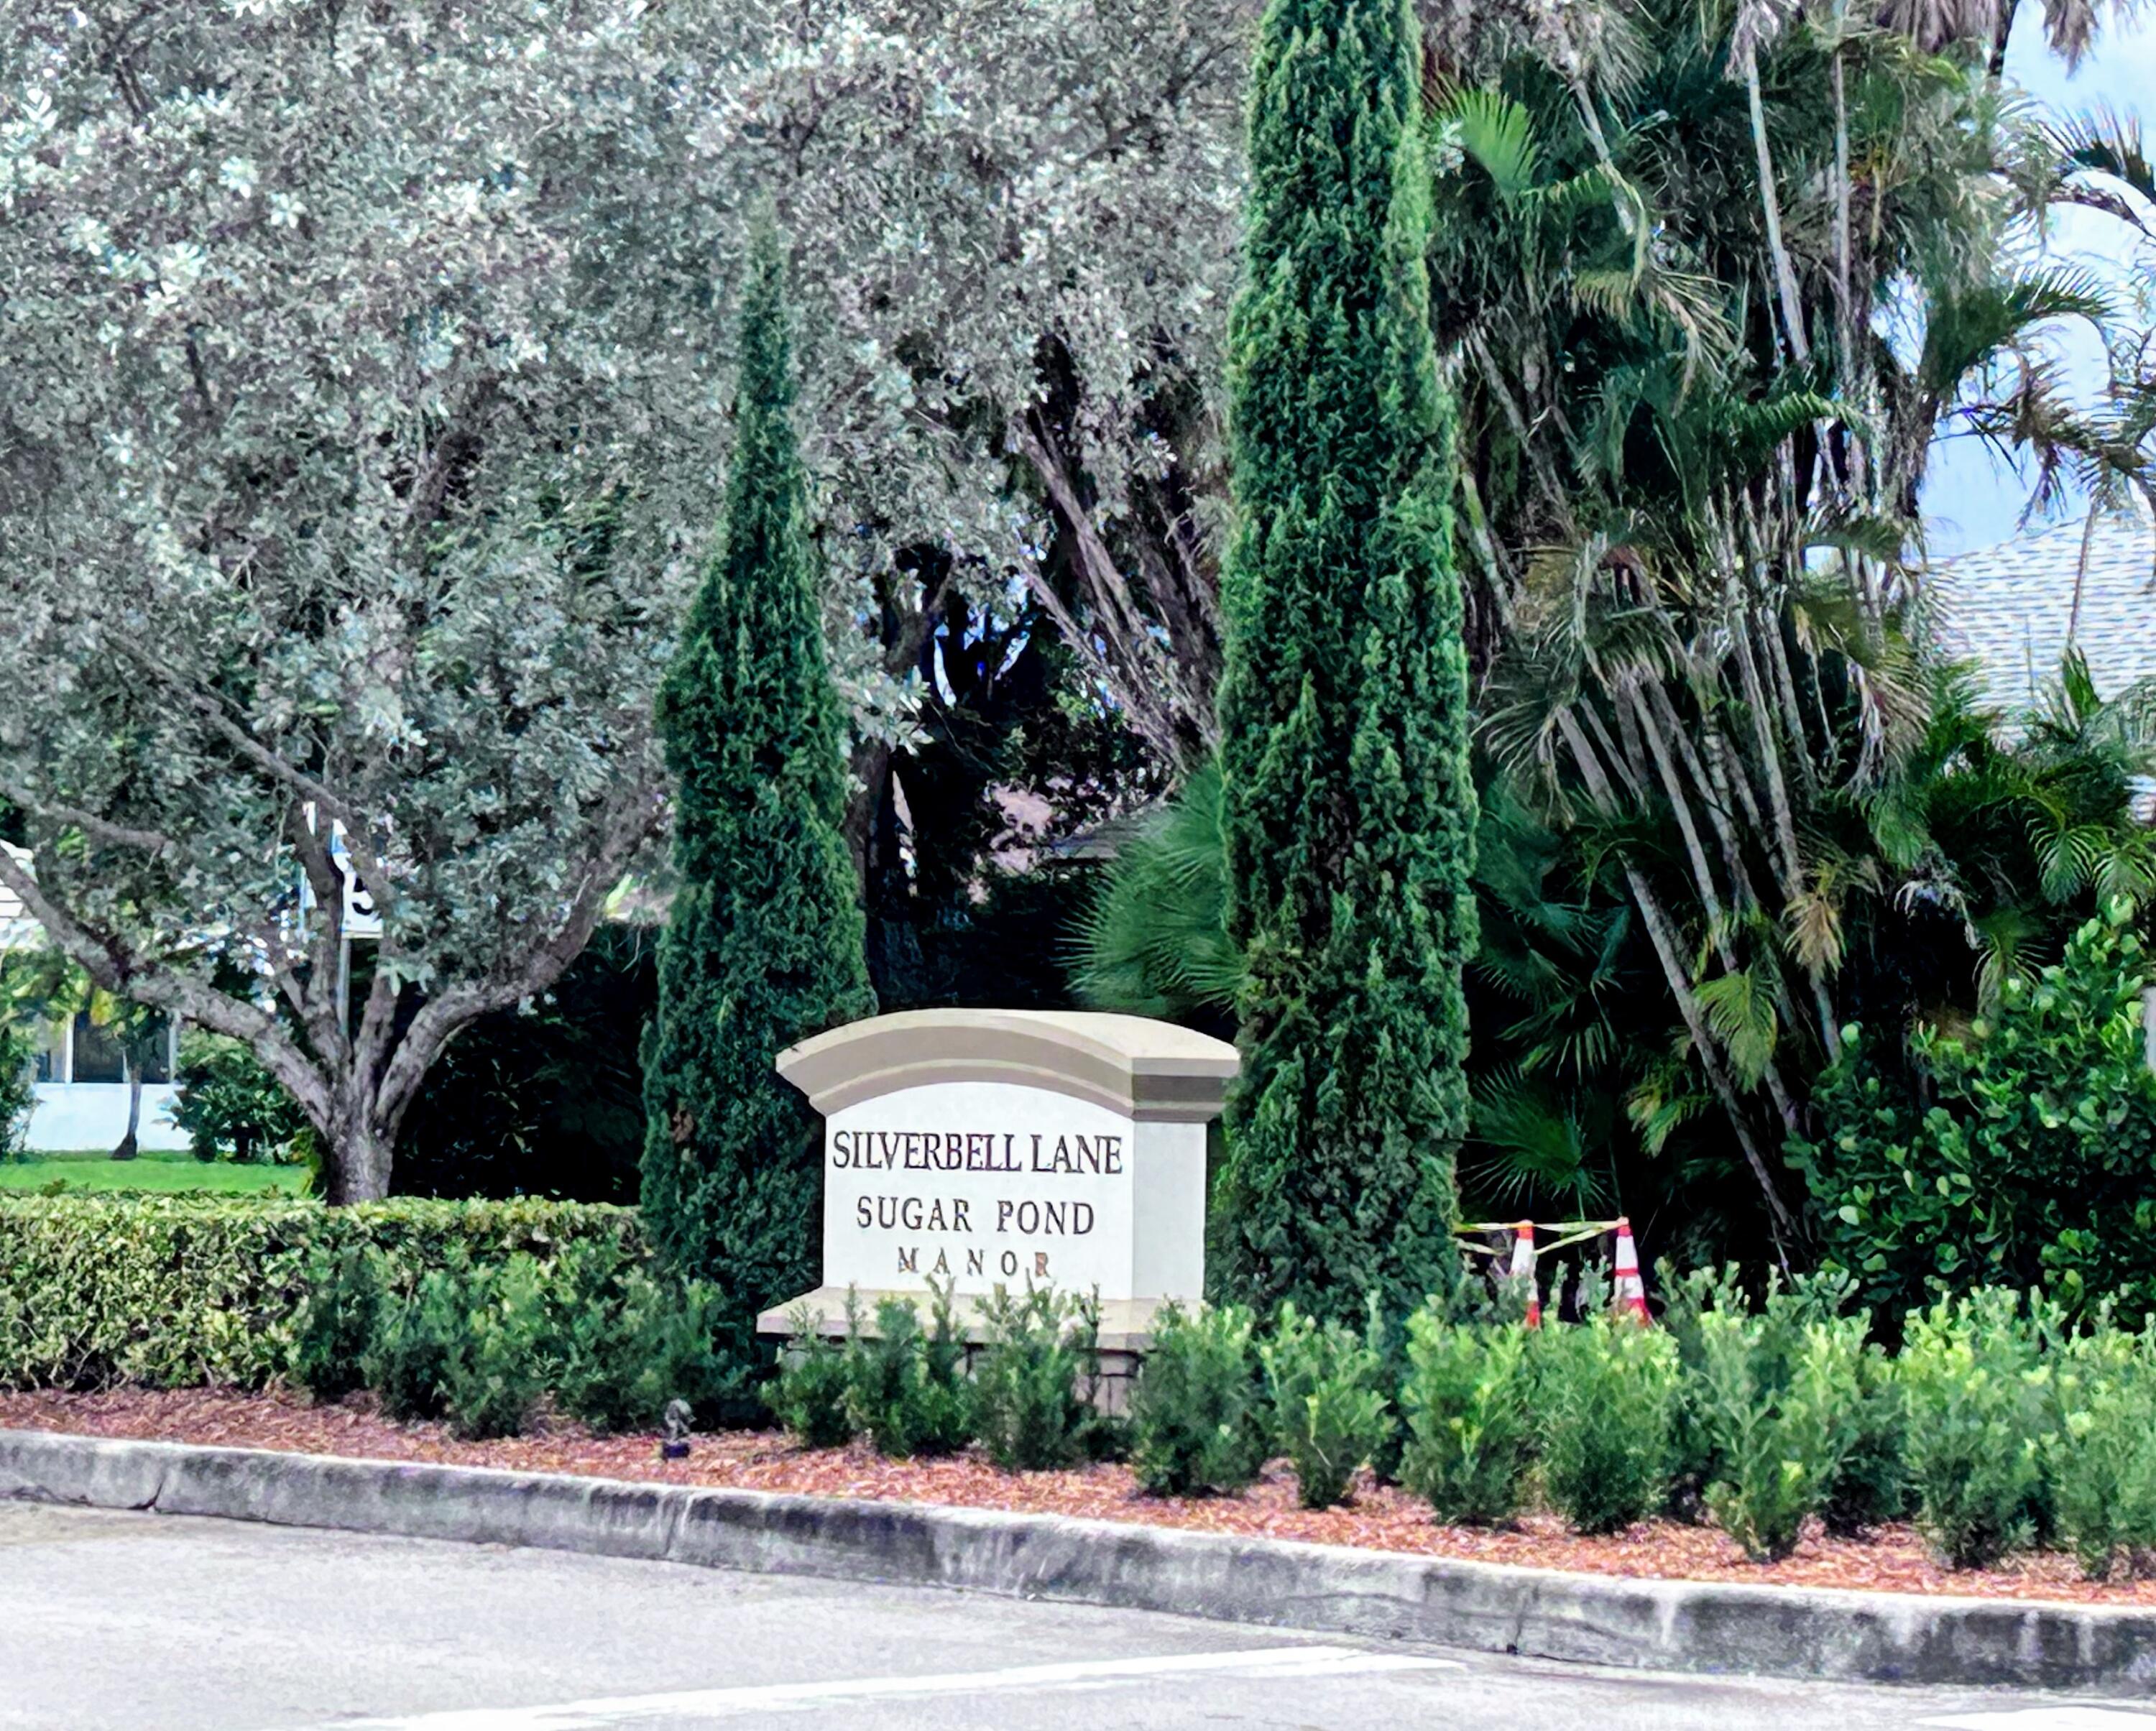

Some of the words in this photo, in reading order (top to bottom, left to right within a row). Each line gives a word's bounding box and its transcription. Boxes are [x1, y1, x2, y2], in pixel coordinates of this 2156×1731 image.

[833, 1130, 1022, 1172] SILVERBELL
[1031, 1135, 1123, 1174] LANE
[857, 1196, 972, 1232] SUGAR
[997, 1201, 1095, 1235] POND
[898, 1247, 1049, 1277] MANOR
